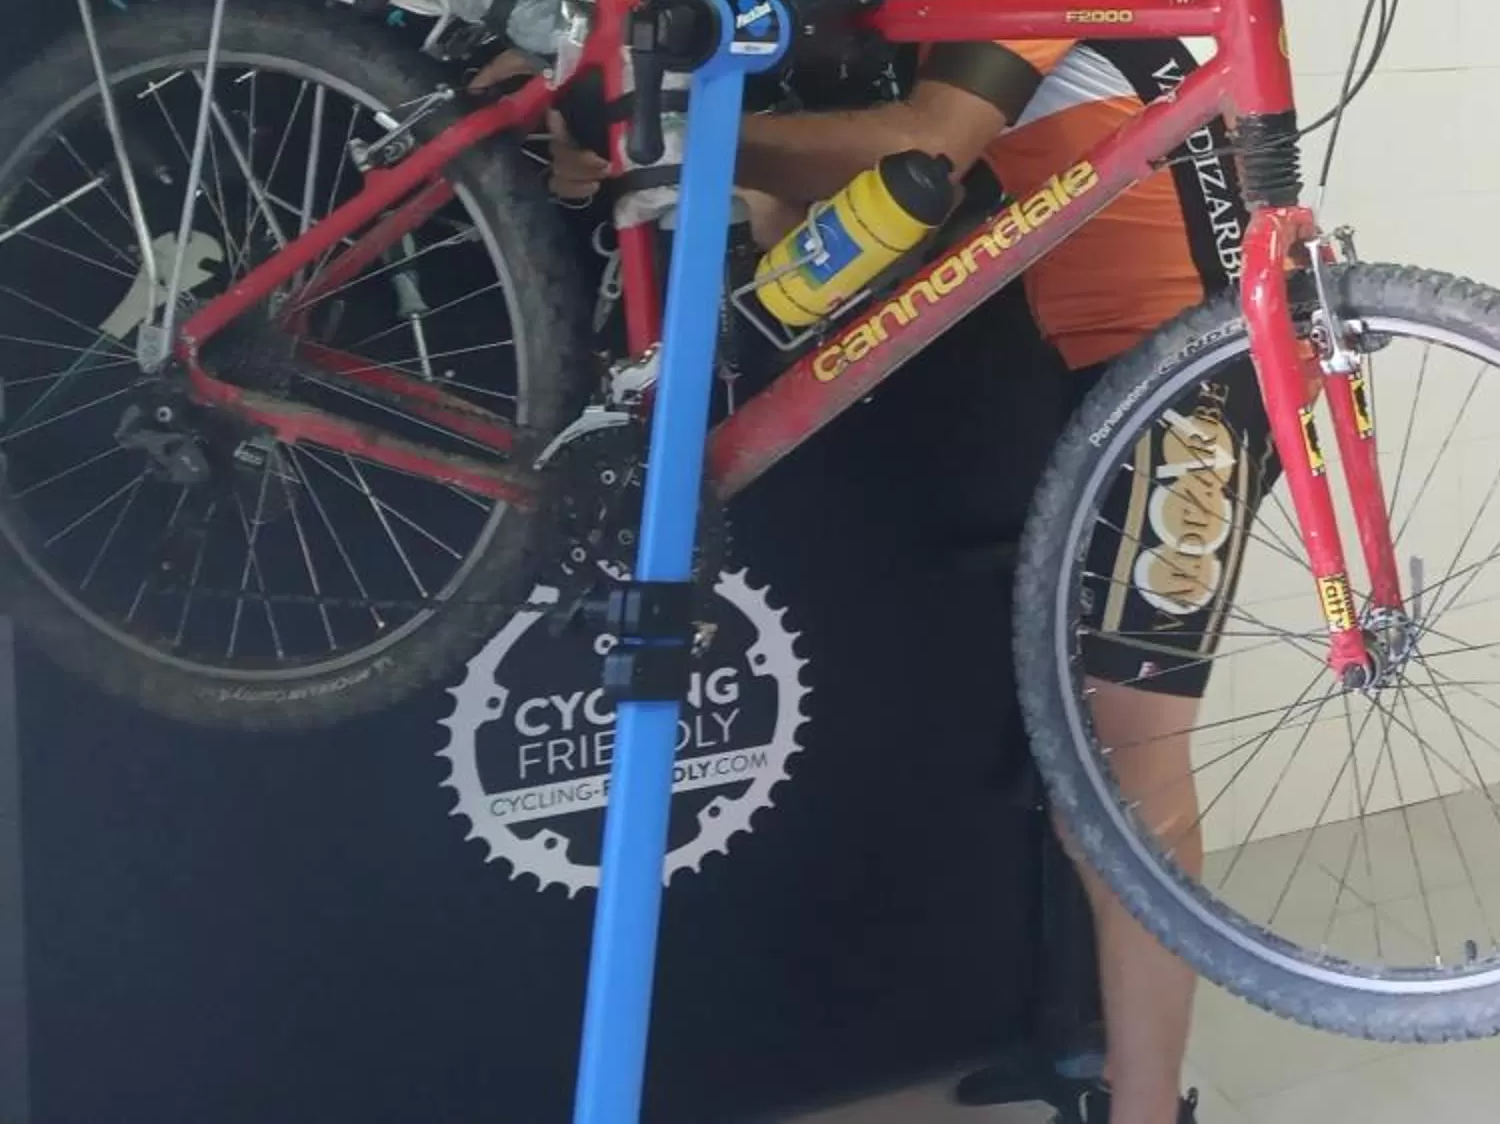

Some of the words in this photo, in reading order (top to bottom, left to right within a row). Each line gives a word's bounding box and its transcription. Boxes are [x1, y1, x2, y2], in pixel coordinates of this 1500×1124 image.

[1065, 8, 1134, 23] F2000
[811, 160, 1099, 382] cannondale
[517, 707, 741, 779] FRIEDLY
